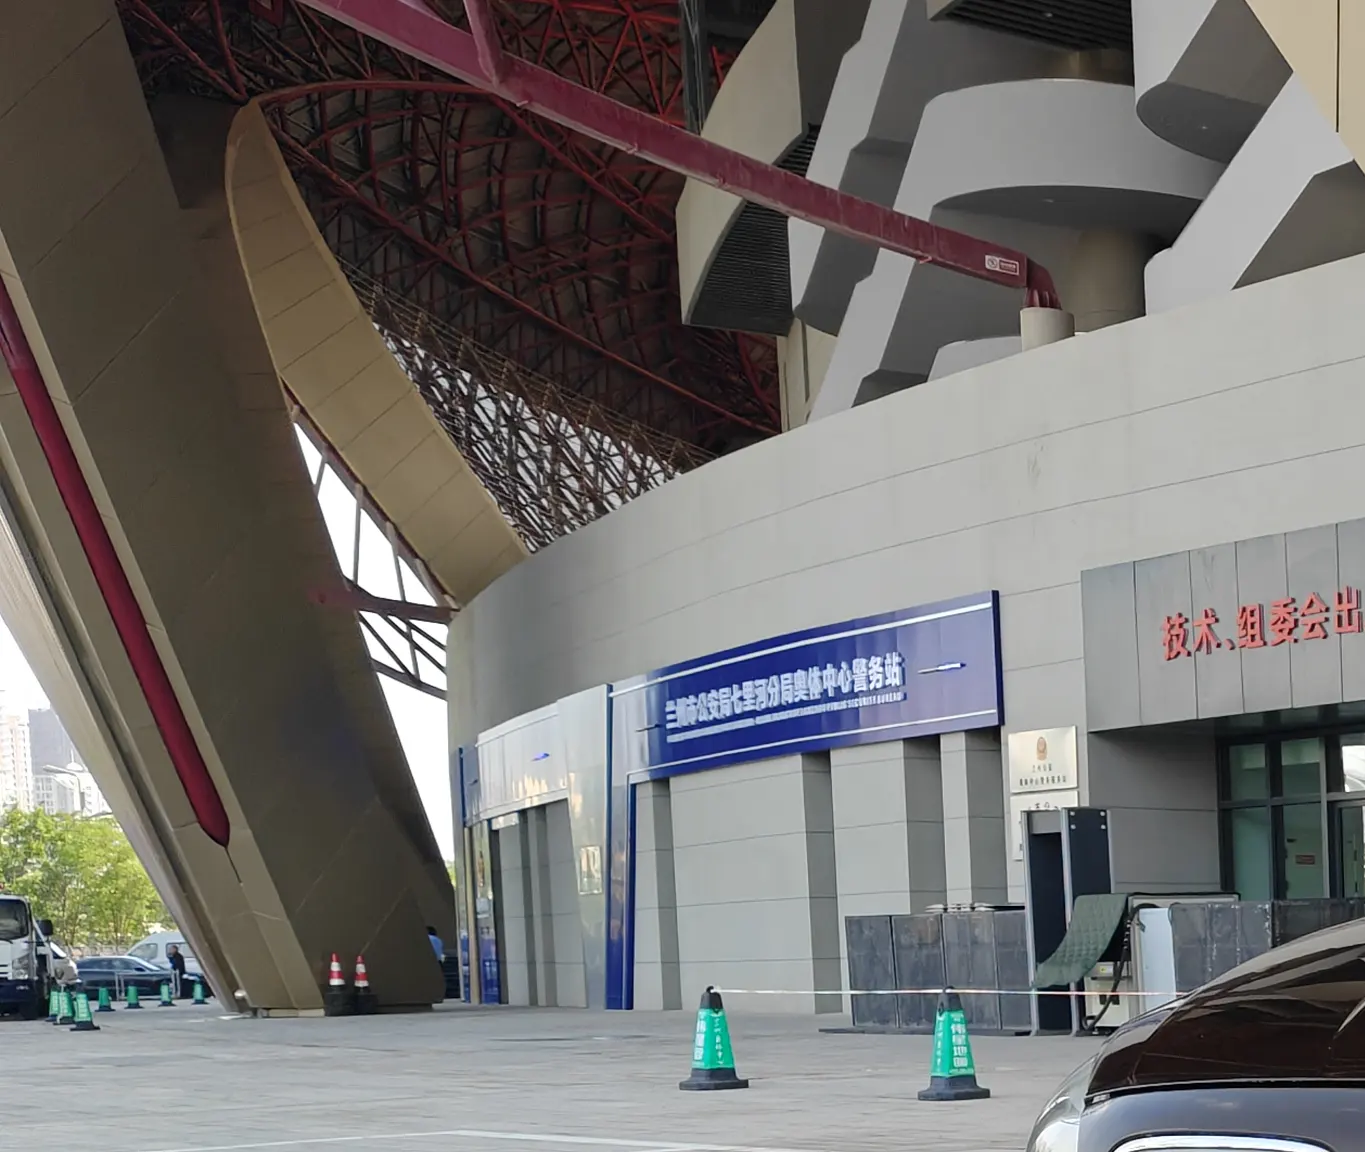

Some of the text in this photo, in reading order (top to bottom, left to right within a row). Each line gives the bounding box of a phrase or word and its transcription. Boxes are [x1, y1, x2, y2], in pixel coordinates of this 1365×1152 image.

[665, 651, 904, 730] 兰州市公安局七里河分局奥体中心警务站
